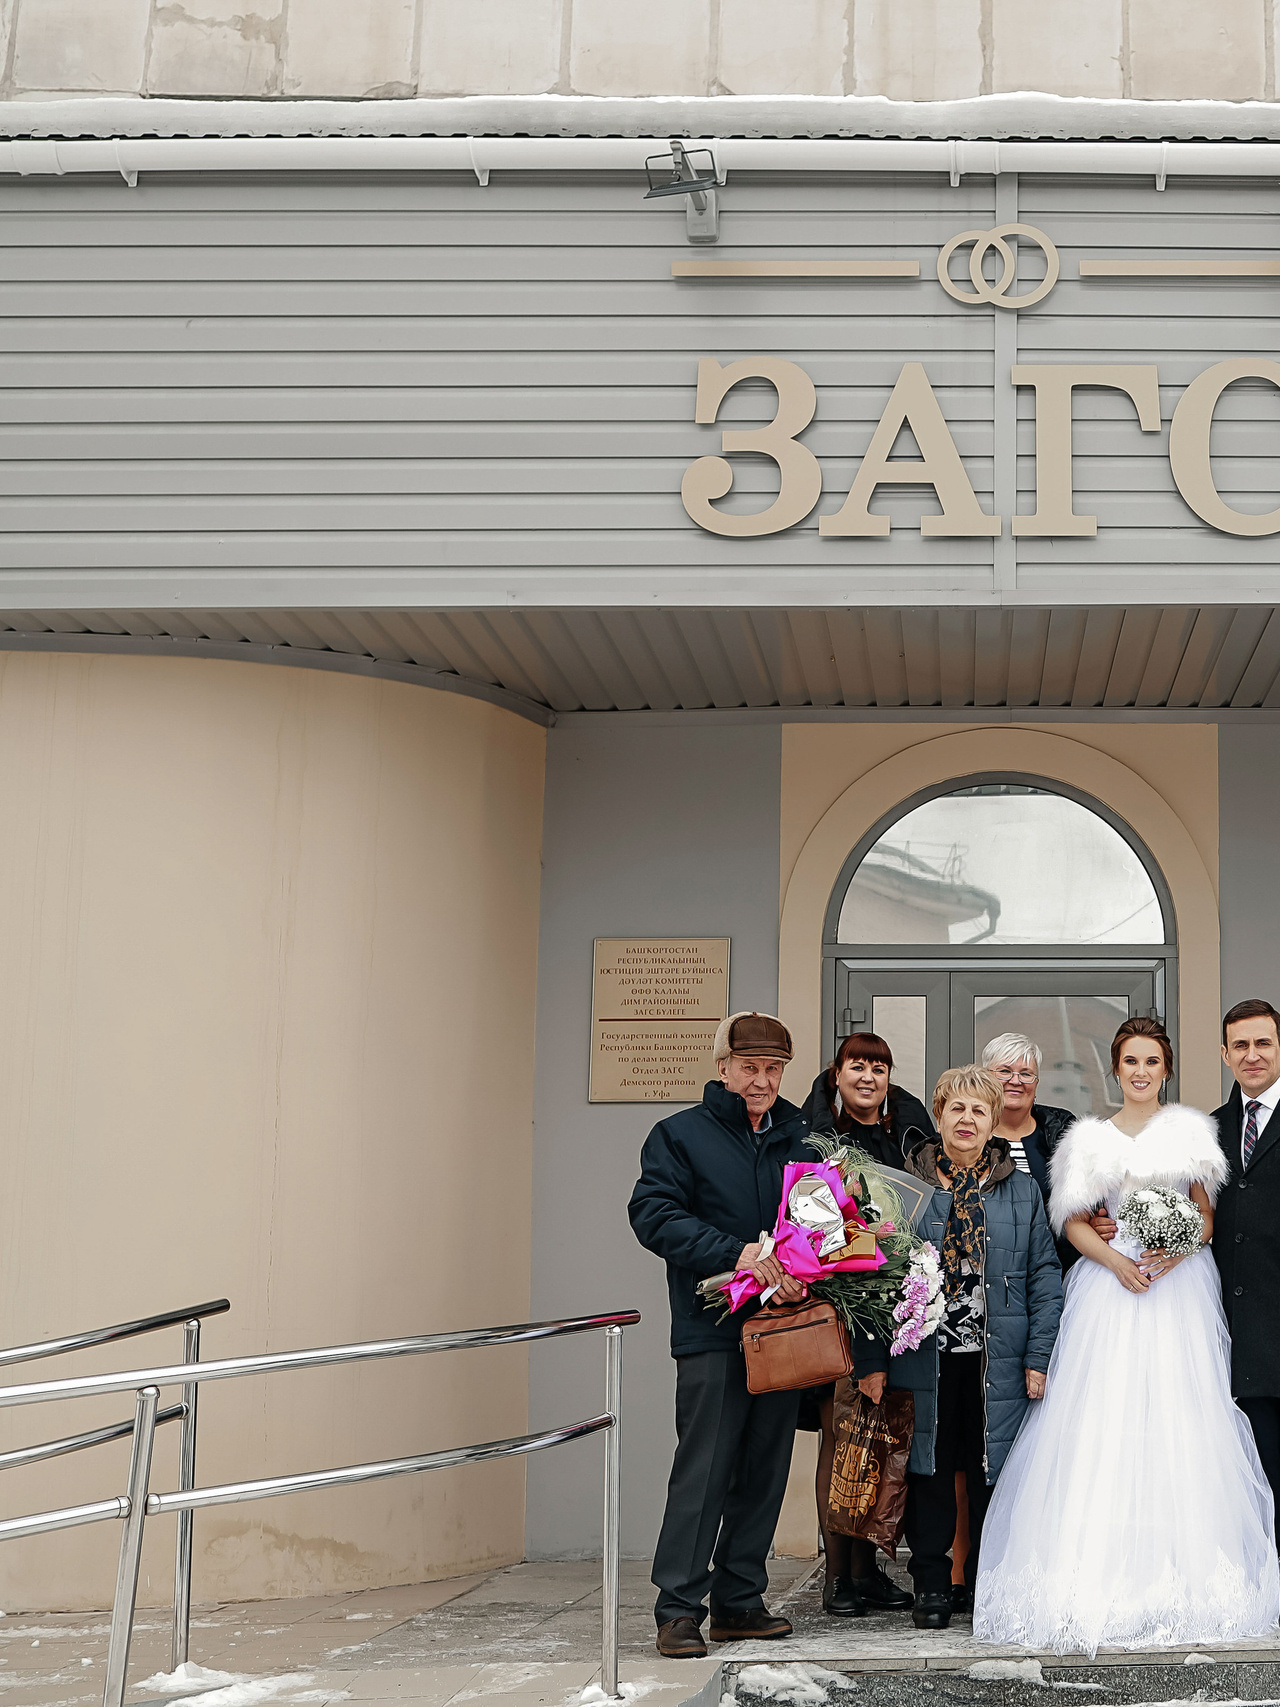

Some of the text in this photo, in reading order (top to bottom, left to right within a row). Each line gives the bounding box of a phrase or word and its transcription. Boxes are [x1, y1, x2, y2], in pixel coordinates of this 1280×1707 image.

[600, 966, 723, 975] ЮСТИЦИЯ ЭШТӘРЕ БУЙЫНСА
[655, 977, 703, 985] КОМИТЕТЫ
[620, 997, 700, 1006] ДИМ РАЙОНЫНЫҢ
[633, 1008, 654, 1016] ЗАГС
[601, 1032, 678, 1041] Государственный
[600, 1044, 652, 1053] Республики
[632, 1066, 685, 1075] Отдел ЗАГС
[619, 1079, 696, 1087] Демского района
[652, 1090, 671, 1099] Уфа
